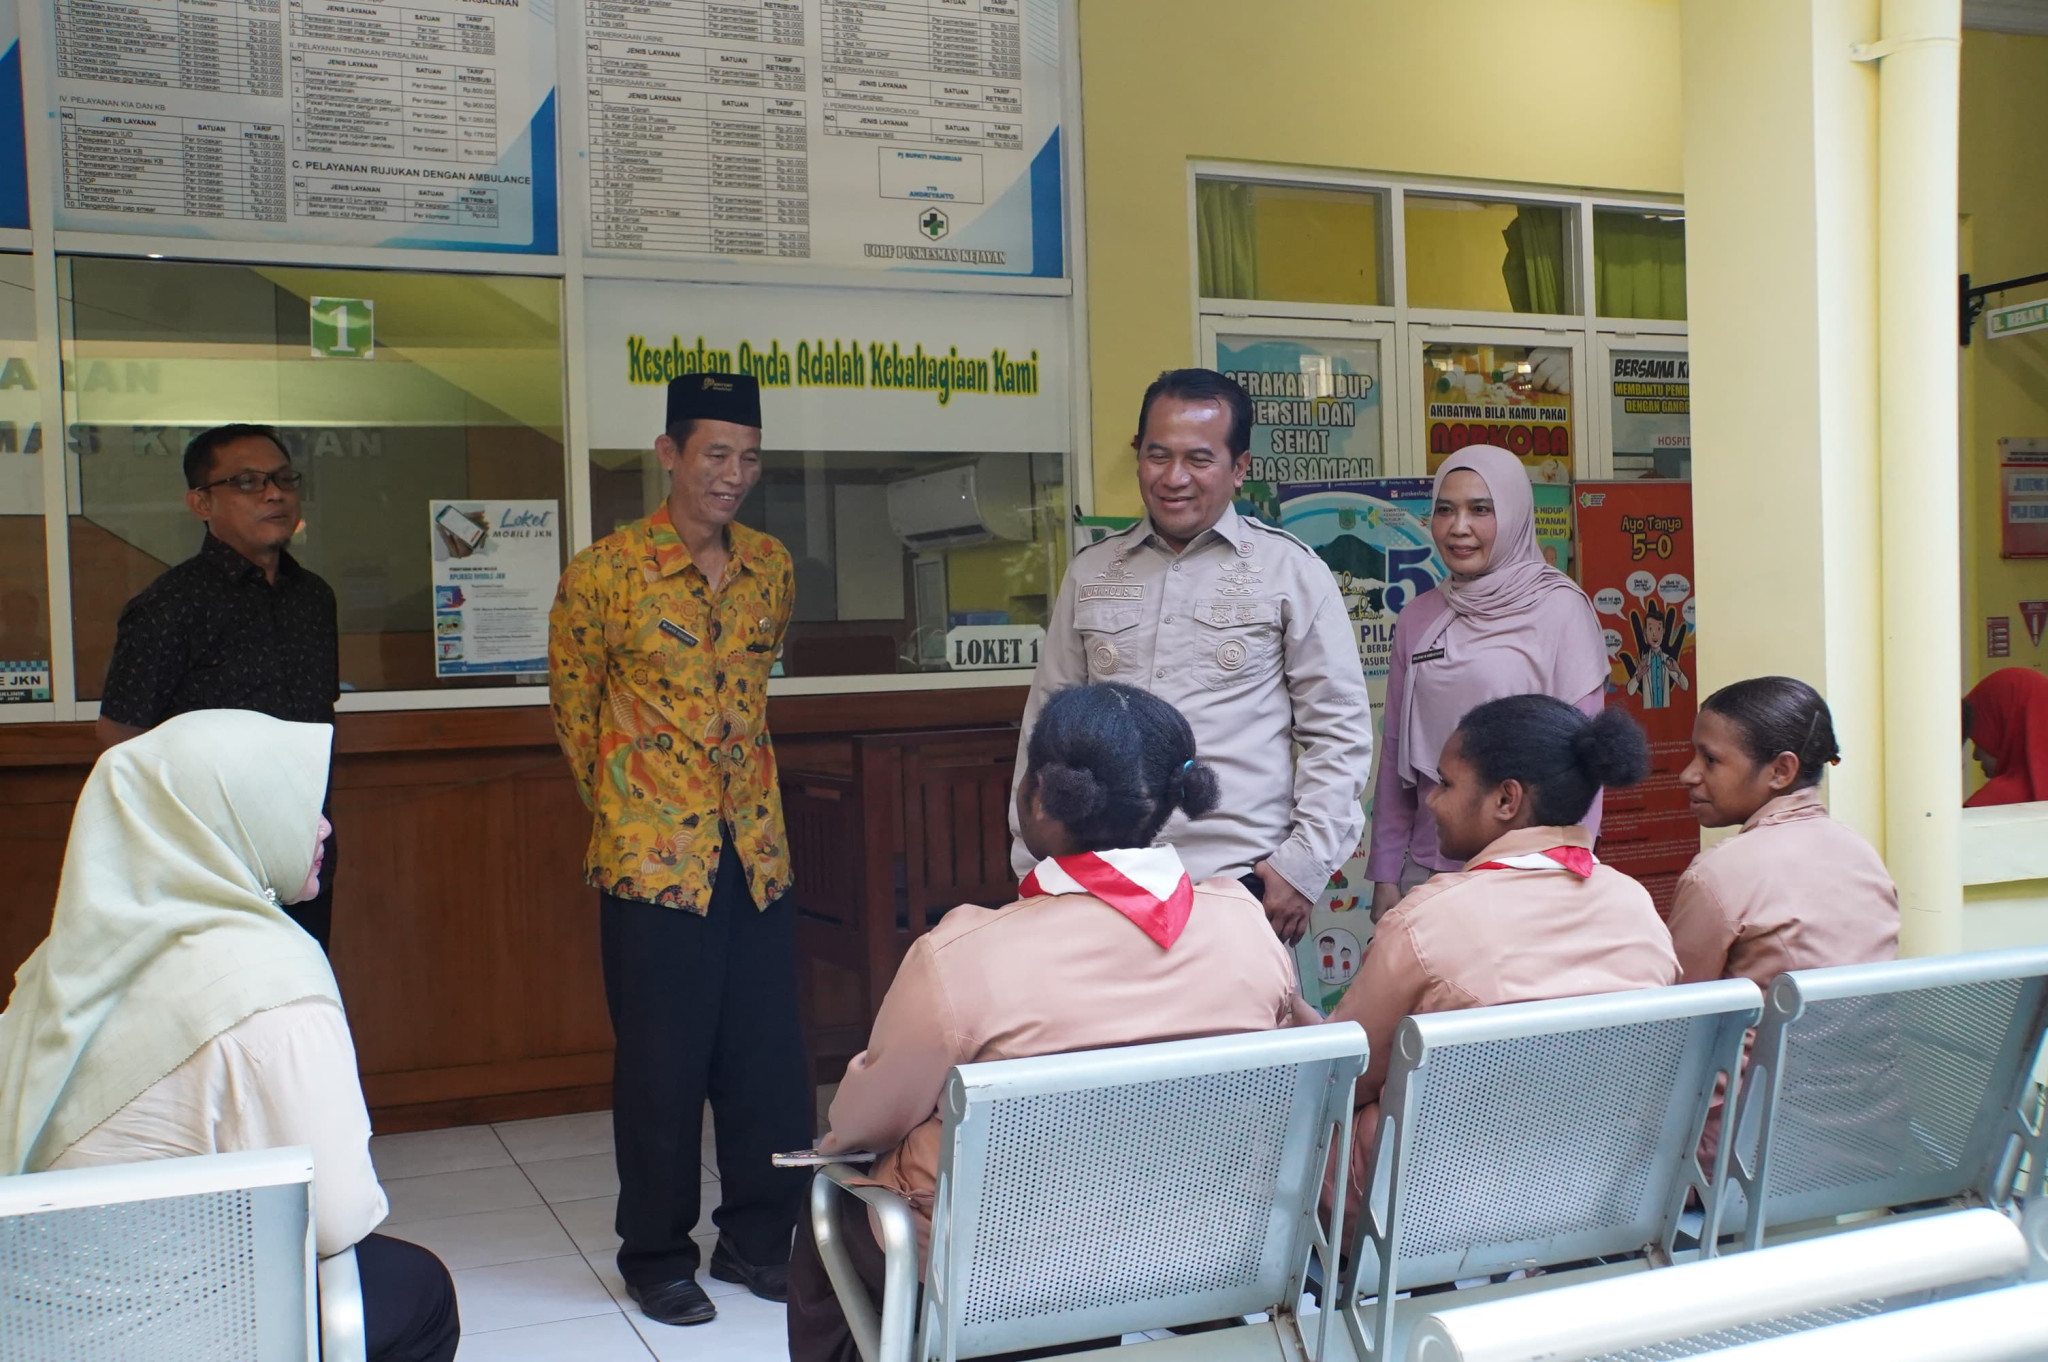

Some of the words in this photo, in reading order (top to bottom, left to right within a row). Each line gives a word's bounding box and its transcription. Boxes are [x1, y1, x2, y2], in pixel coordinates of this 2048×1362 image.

[415, 14, 440, 22] SATUAN
[648, 50, 681, 58] LAYANAN
[878, 82, 908, 90] LAYANAN
[71, 97, 119, 107] PELAYANAN
[121, 100, 134, 108] KIA
[649, 94, 682, 102] LAYANAN
[102, 116, 122, 124] JENIS
[124, 118, 156, 126] LAYANAN
[198, 124, 226, 132] SATUAN
[879, 119, 908, 127] LAYANAN
[306, 161, 367, 173] PELAYANAN
[370, 166, 420, 177] RUJUKAN
[423, 170, 466, 180] DENGAN
[468, 173, 531, 185] AMBULANCE
[896, 245, 958, 262] PUSKESMAS
[961, 249, 1006, 265] KEJAYAN
[330, 304, 356, 352] 1
[627, 334, 731, 385] Kesehatan
[738, 338, 791, 388] Anda
[798, 340, 865, 388] Adalah
[868, 341, 990, 406] Kebahagiaan
[992, 346, 1040, 396] Kami
[1615, 359, 1674, 379] BERSAMA
[1614, 382, 1664, 397] MEMBANTU
[1317, 402, 1355, 427] DAN
[1431, 405, 1482, 418] AKIBATNYA
[1485, 406, 1506, 418] BILA
[1509, 407, 1536, 420] KAMU
[1540, 408, 1566, 420] PAKAI
[1625, 398, 1660, 413] DENGAN
[1271, 429, 1329, 454] SEHAT
[1430, 422, 1568, 456] NARKOBA
[1295, 458, 1373, 480] SAMPAH
[500, 508, 554, 528] Loket
[1622, 516, 1643, 534] Ayo
[1647, 516, 1683, 534] Tanya
[492, 530, 530, 538] MOBILE
[534, 530, 552, 538] JKN
[1632, 532, 1673, 561] 5-0
[1384, 546, 1436, 614] 5
[955, 638, 1022, 665] LOKET
[1030, 638, 1038, 663] 1
[10, 676, 41, 686] JKN
